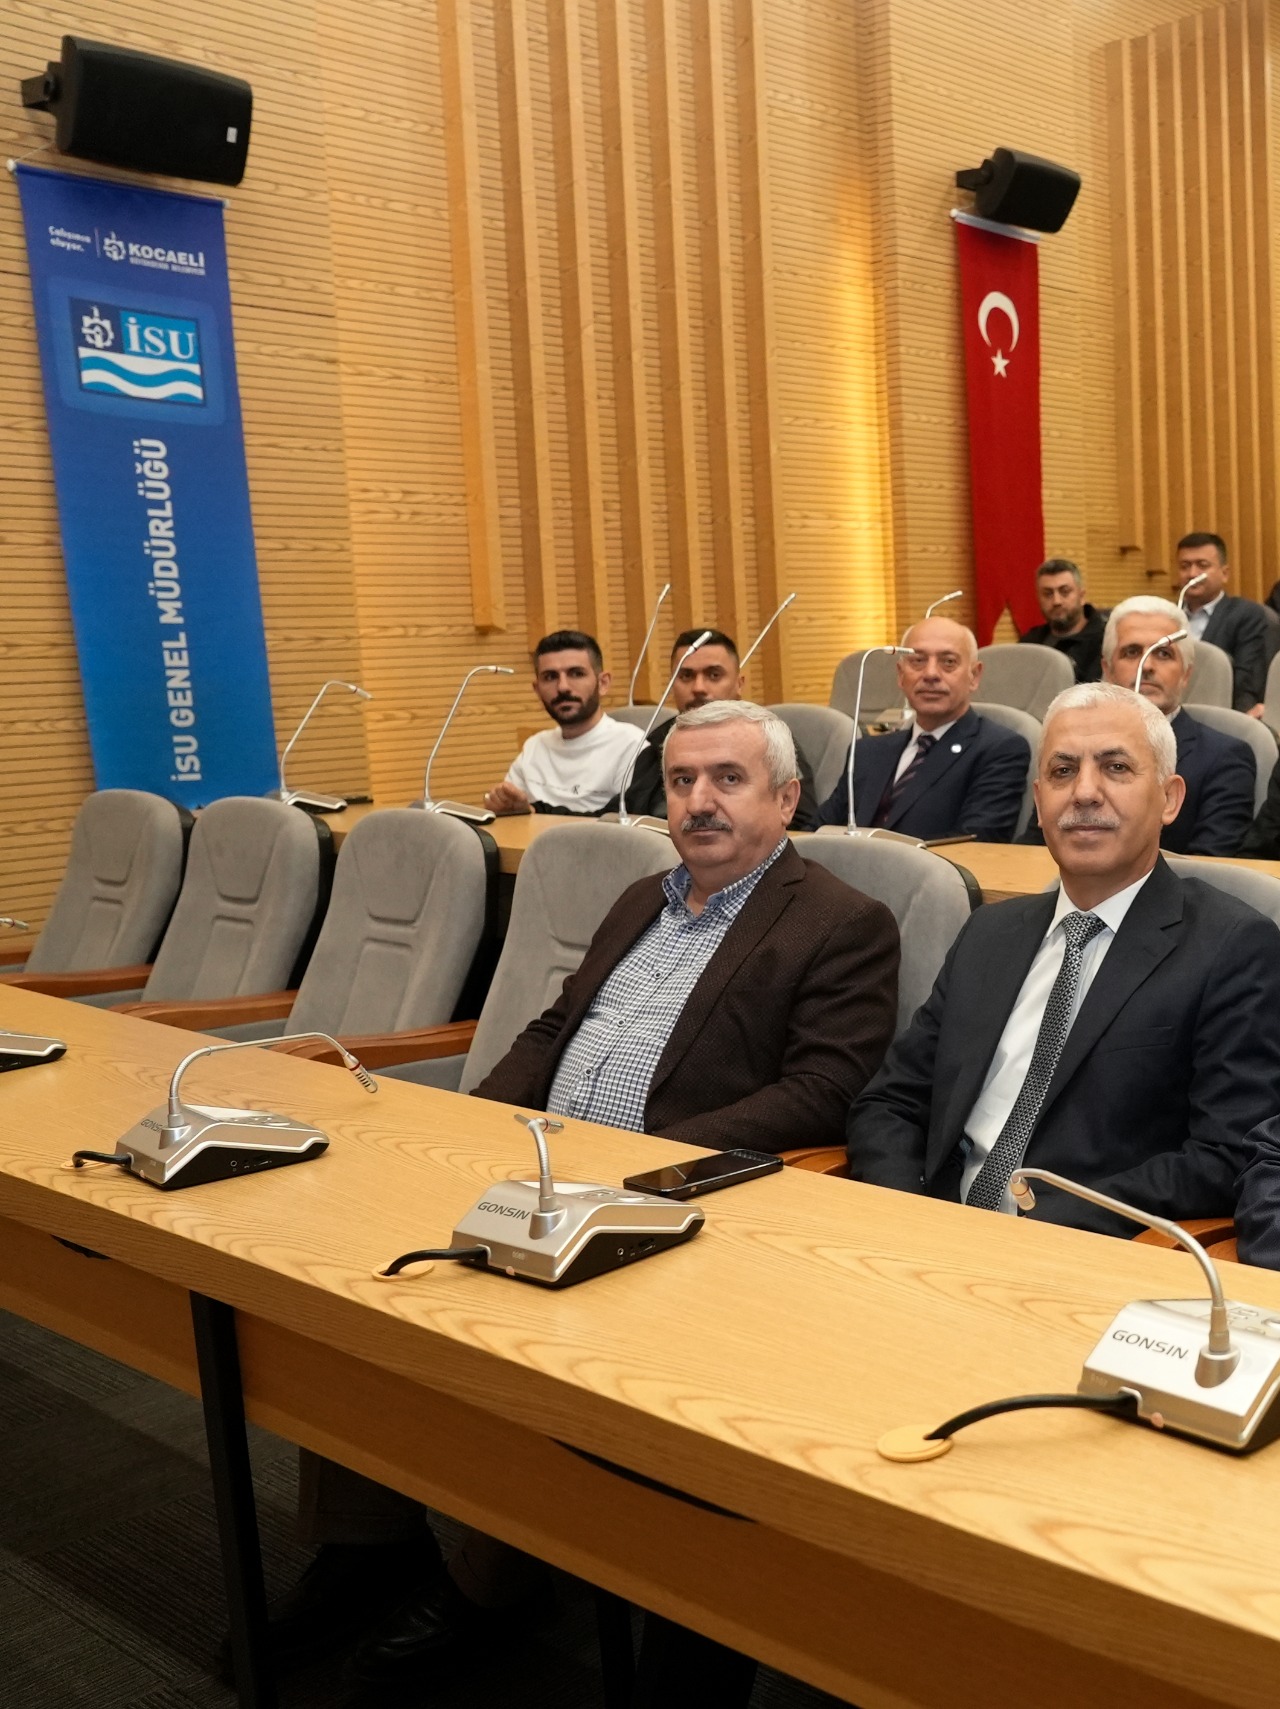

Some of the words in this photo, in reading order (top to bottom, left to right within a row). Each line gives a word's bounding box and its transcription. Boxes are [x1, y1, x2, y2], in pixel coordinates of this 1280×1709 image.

[129, 243, 205, 268] KOCAELİ
[126, 317, 195, 359] İSU
[133, 438, 185, 624] MÜDÜRLÜĞÜ
[162, 632, 196, 728] GENEL
[170, 735, 202, 782] İSU
[478, 1202, 530, 1220] GONSIN
[1112, 1330, 1189, 1359] GONSIN
